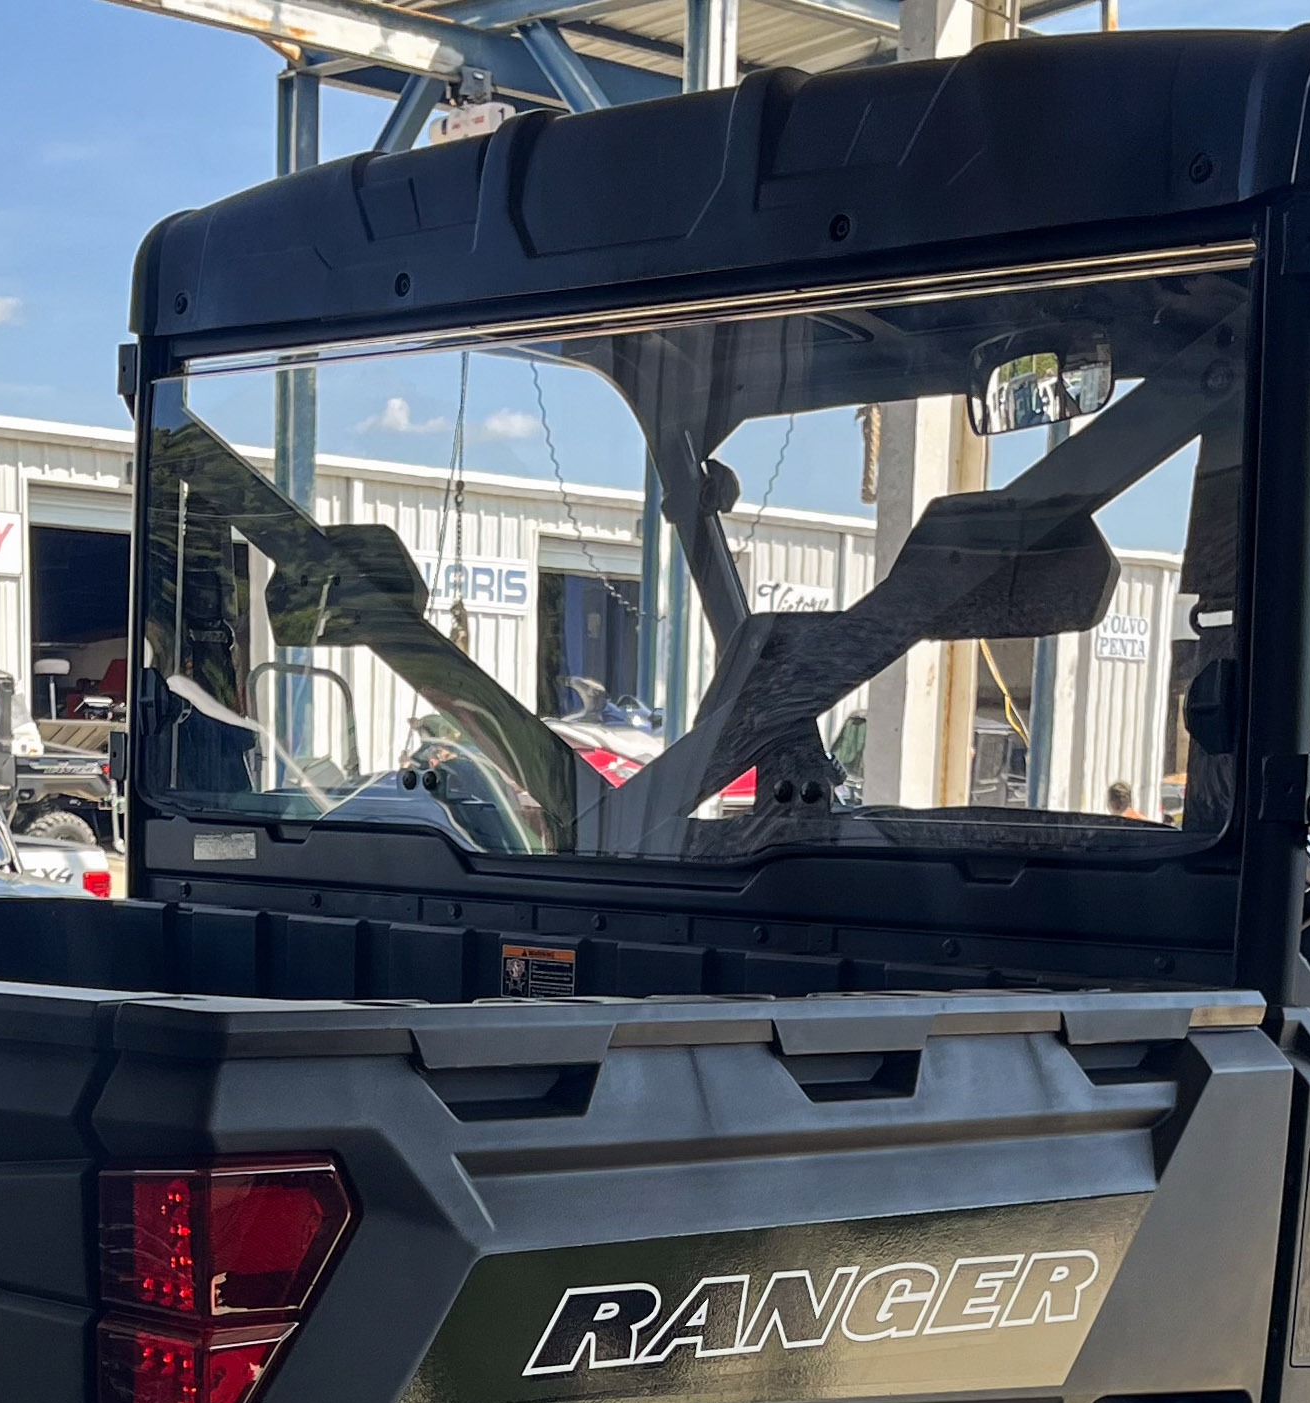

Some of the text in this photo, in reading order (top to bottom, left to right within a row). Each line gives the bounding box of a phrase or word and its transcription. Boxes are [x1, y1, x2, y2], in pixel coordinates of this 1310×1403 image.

[1102, 615, 1148, 636] VOLVO
[1099, 637, 1146, 658] PENTA
[522, 1250, 1099, 1377] RANGER
